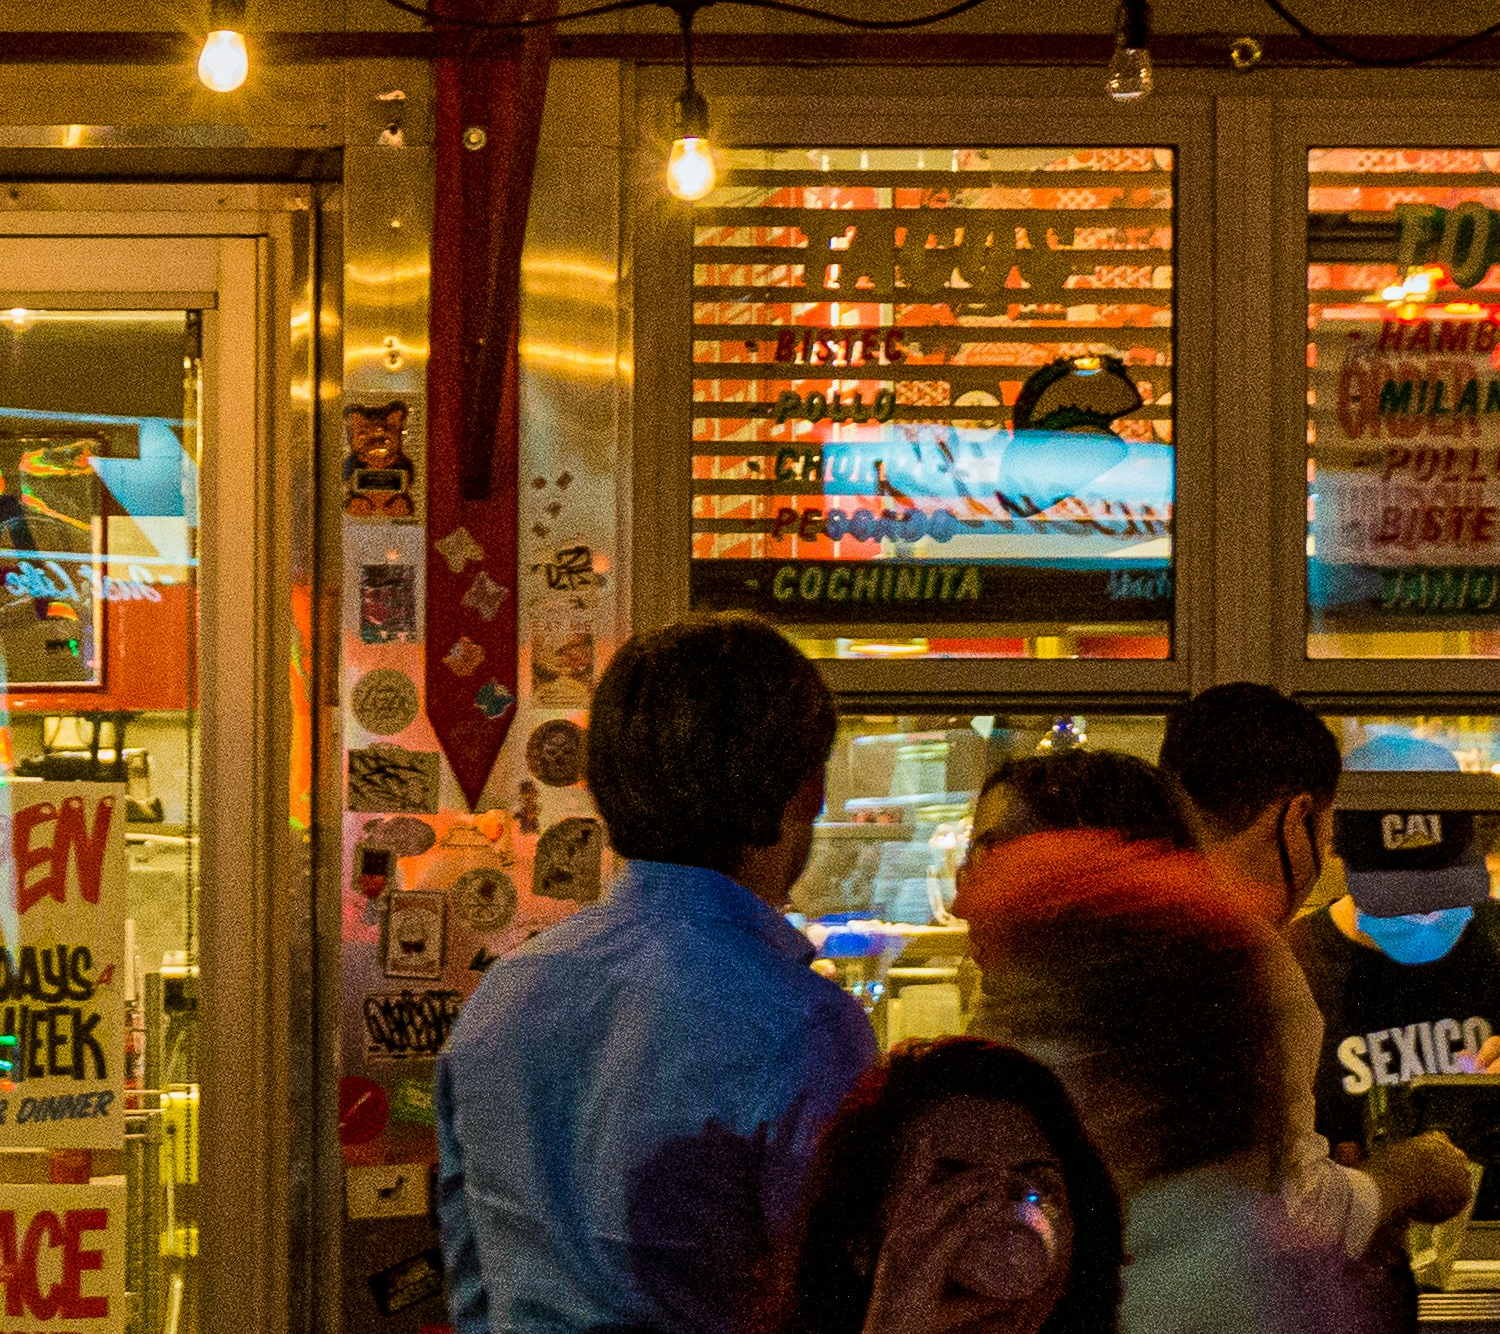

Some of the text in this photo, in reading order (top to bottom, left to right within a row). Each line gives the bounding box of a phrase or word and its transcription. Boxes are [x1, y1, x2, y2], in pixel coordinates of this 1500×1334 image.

[775, 328, 906, 365] BISTEC
[775, 390, 899, 424] POLLO
[773, 565, 983, 602] COCHINITA
[1382, 814, 1443, 851] CAT
[16, 1090, 115, 1126] DINNER
